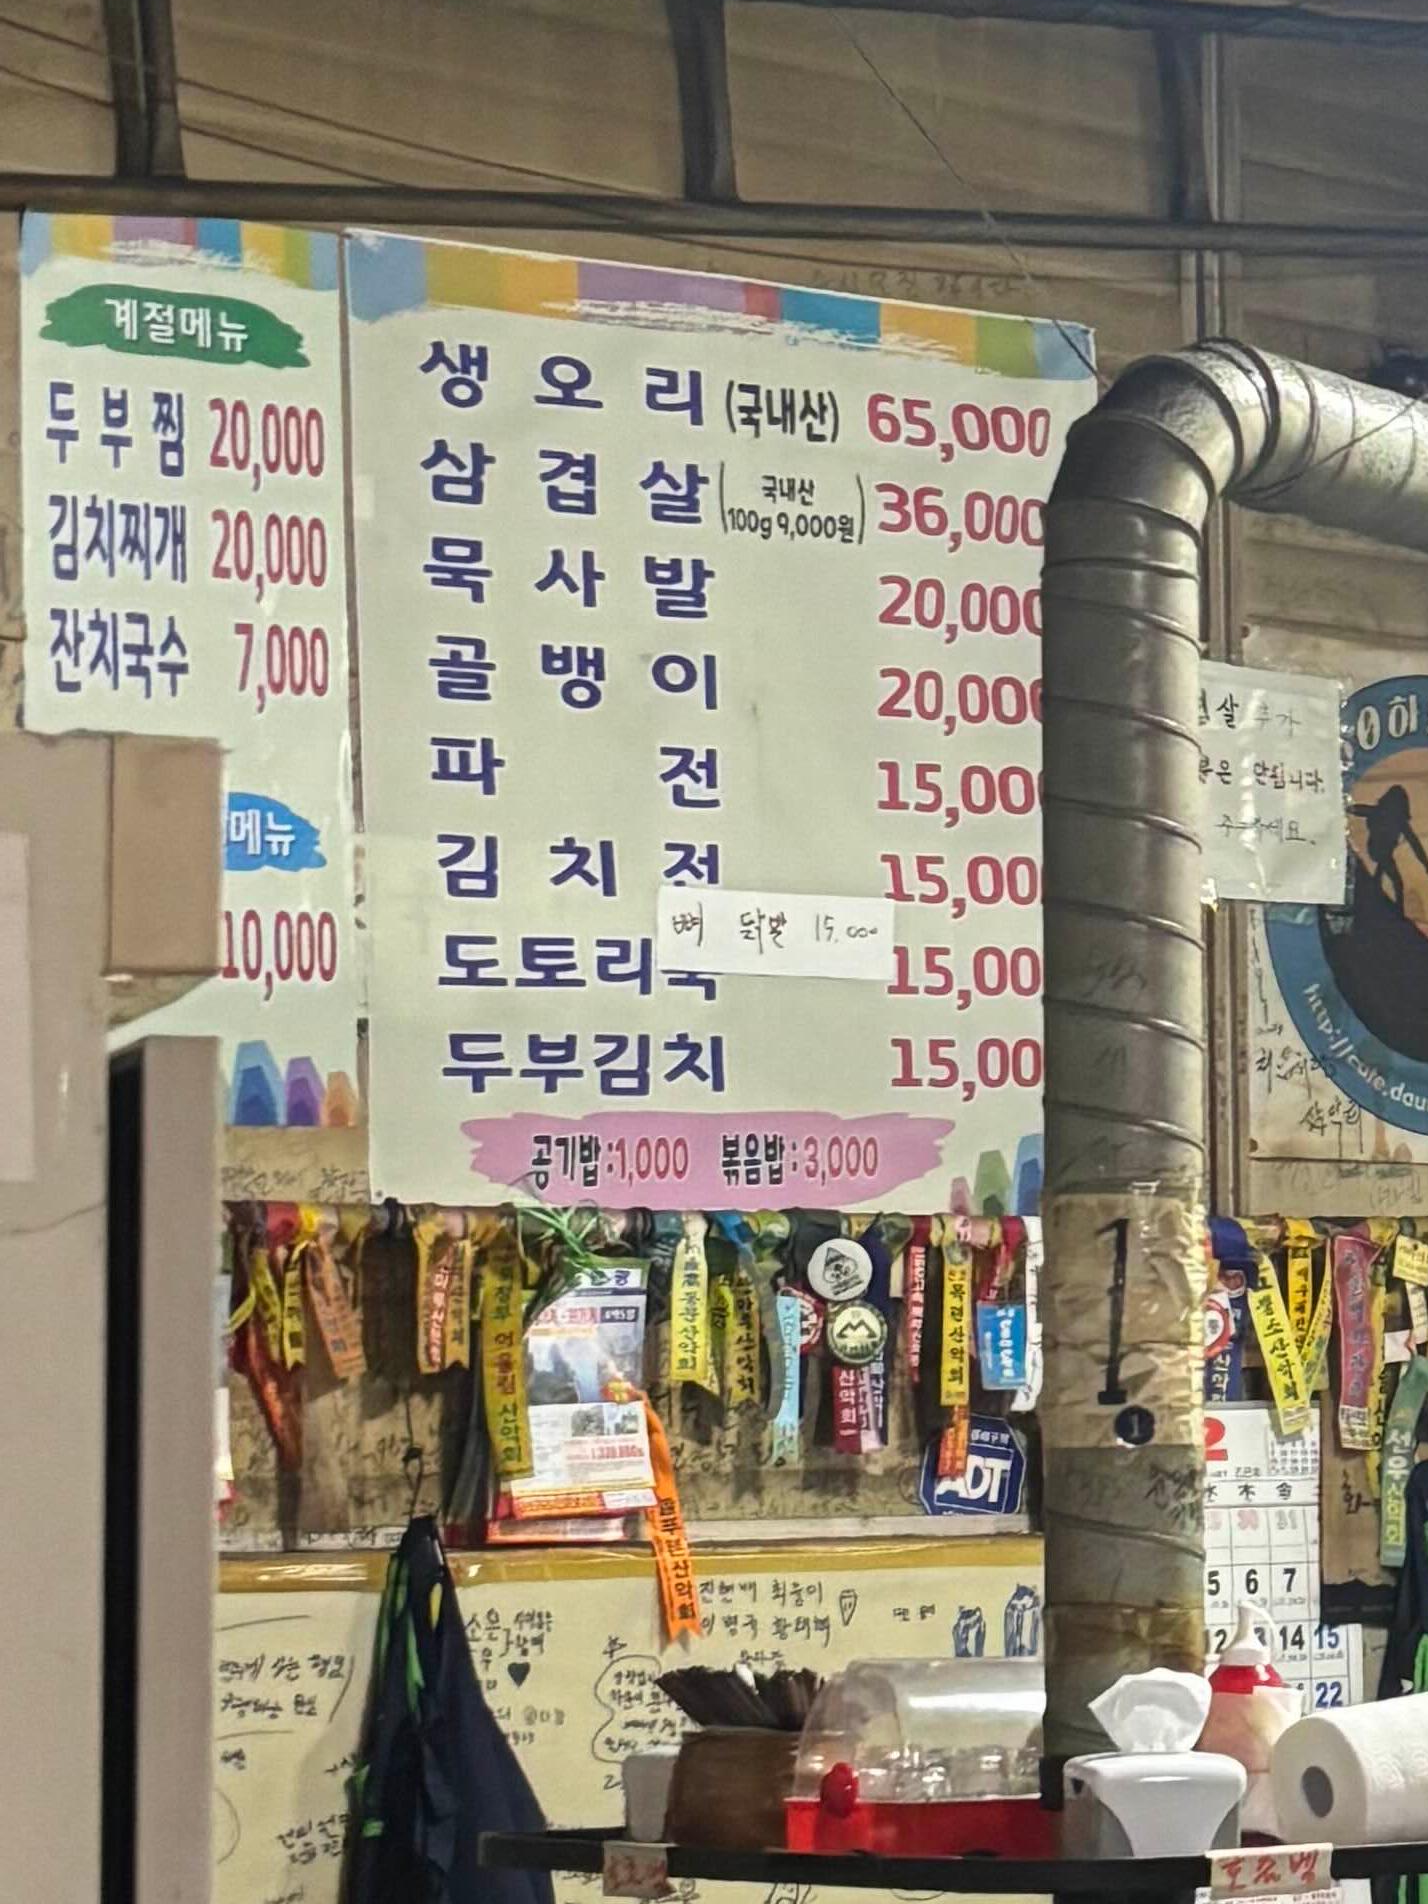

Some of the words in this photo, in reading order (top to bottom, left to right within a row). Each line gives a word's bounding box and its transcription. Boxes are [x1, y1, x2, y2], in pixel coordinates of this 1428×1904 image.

[104, 297, 250, 352] 계절메뉴
[209, 397, 325, 492] 20,000
[725, 379, 840, 444] (국내산)
[866, 393, 1052, 463] 65,000
[48, 495, 188, 583] 김치찌개
[211, 509, 328, 604] 20,000
[874, 482, 1044, 554] 36,000
[50, 608, 190, 696] 잔치국수
[234, 623, 330, 712] 7,000
[877, 761, 1043, 830] 15,00
[226, 809, 296, 858] 메뉴
[880, 853, 1043, 920] 15,00
[221, 911, 337, 1001] 10,000
[886, 944, 1043, 1012] 15,00
[442, 1032, 725, 1095] 두부김치
[890, 1038, 1043, 1102] 15,00
[1245, 1569, 1259, 1594] 6
[1283, 1568, 1296, 1593] 7
[1280, 1626, 1304, 1649] 14
[1316, 1624, 1340, 1648] 15
[1316, 1682, 1342, 1707] 22
